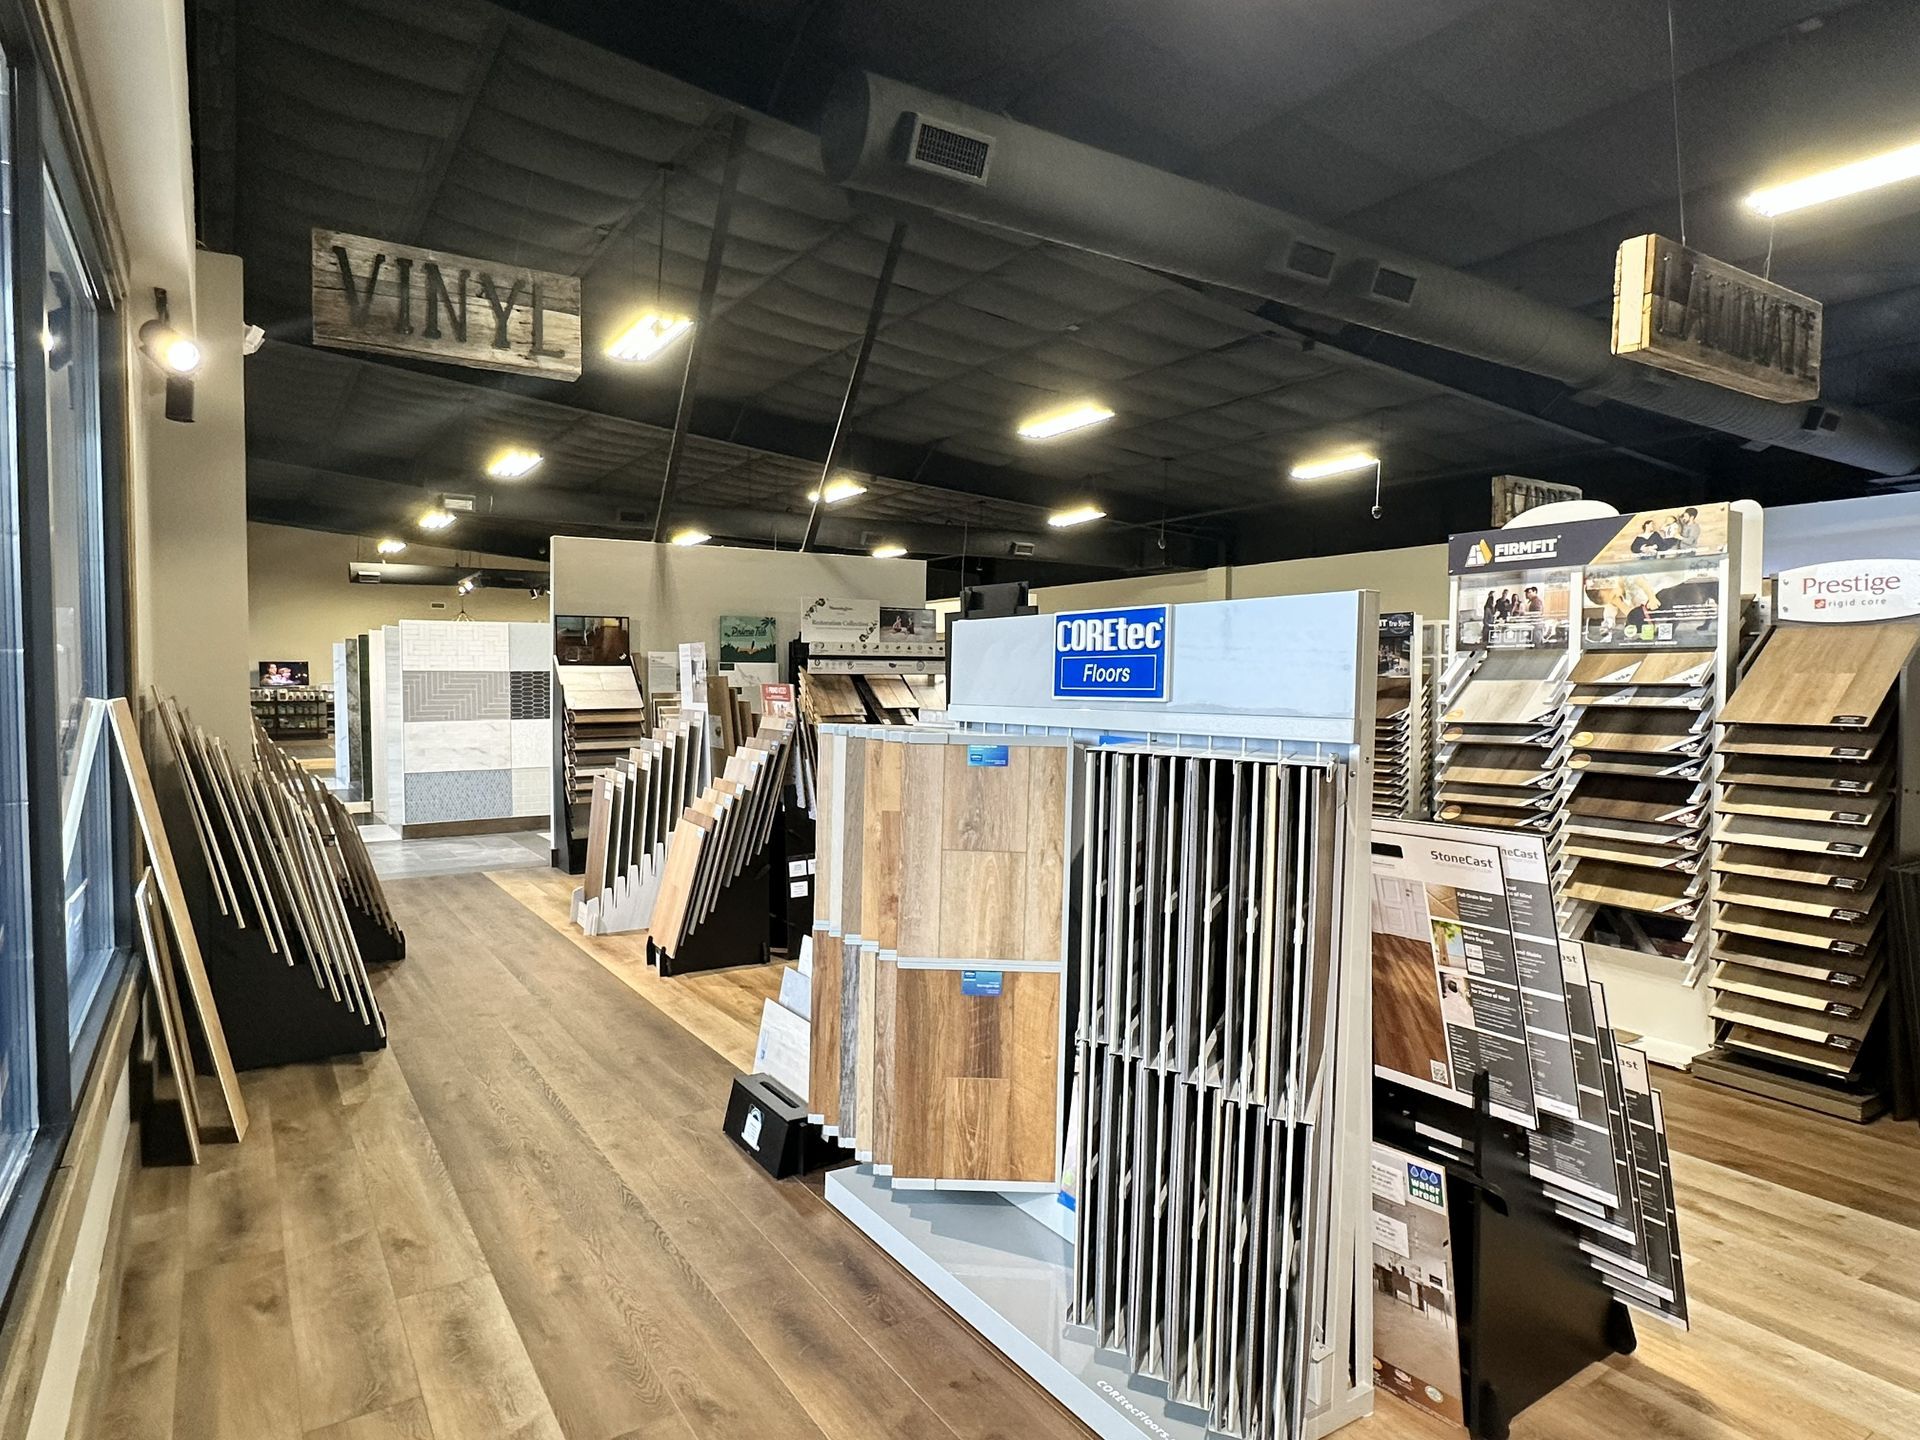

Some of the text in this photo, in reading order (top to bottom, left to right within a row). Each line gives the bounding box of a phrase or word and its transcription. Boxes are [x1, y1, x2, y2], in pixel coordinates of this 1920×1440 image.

[331, 245, 566, 359] VINYL
[1494, 538, 1558, 557] FIRMFIT
[1802, 573, 1901, 596] Prestige
[1828, 597, 1887, 609] rigid core
[1056, 617, 1162, 653] COREtec
[1082, 663, 1131, 683] Floors
[1430, 850, 1493, 869] StoneCast
[1501, 848, 1539, 860] neCast
[1410, 1178, 1441, 1194] water
[1412, 1187, 1440, 1204] proof
